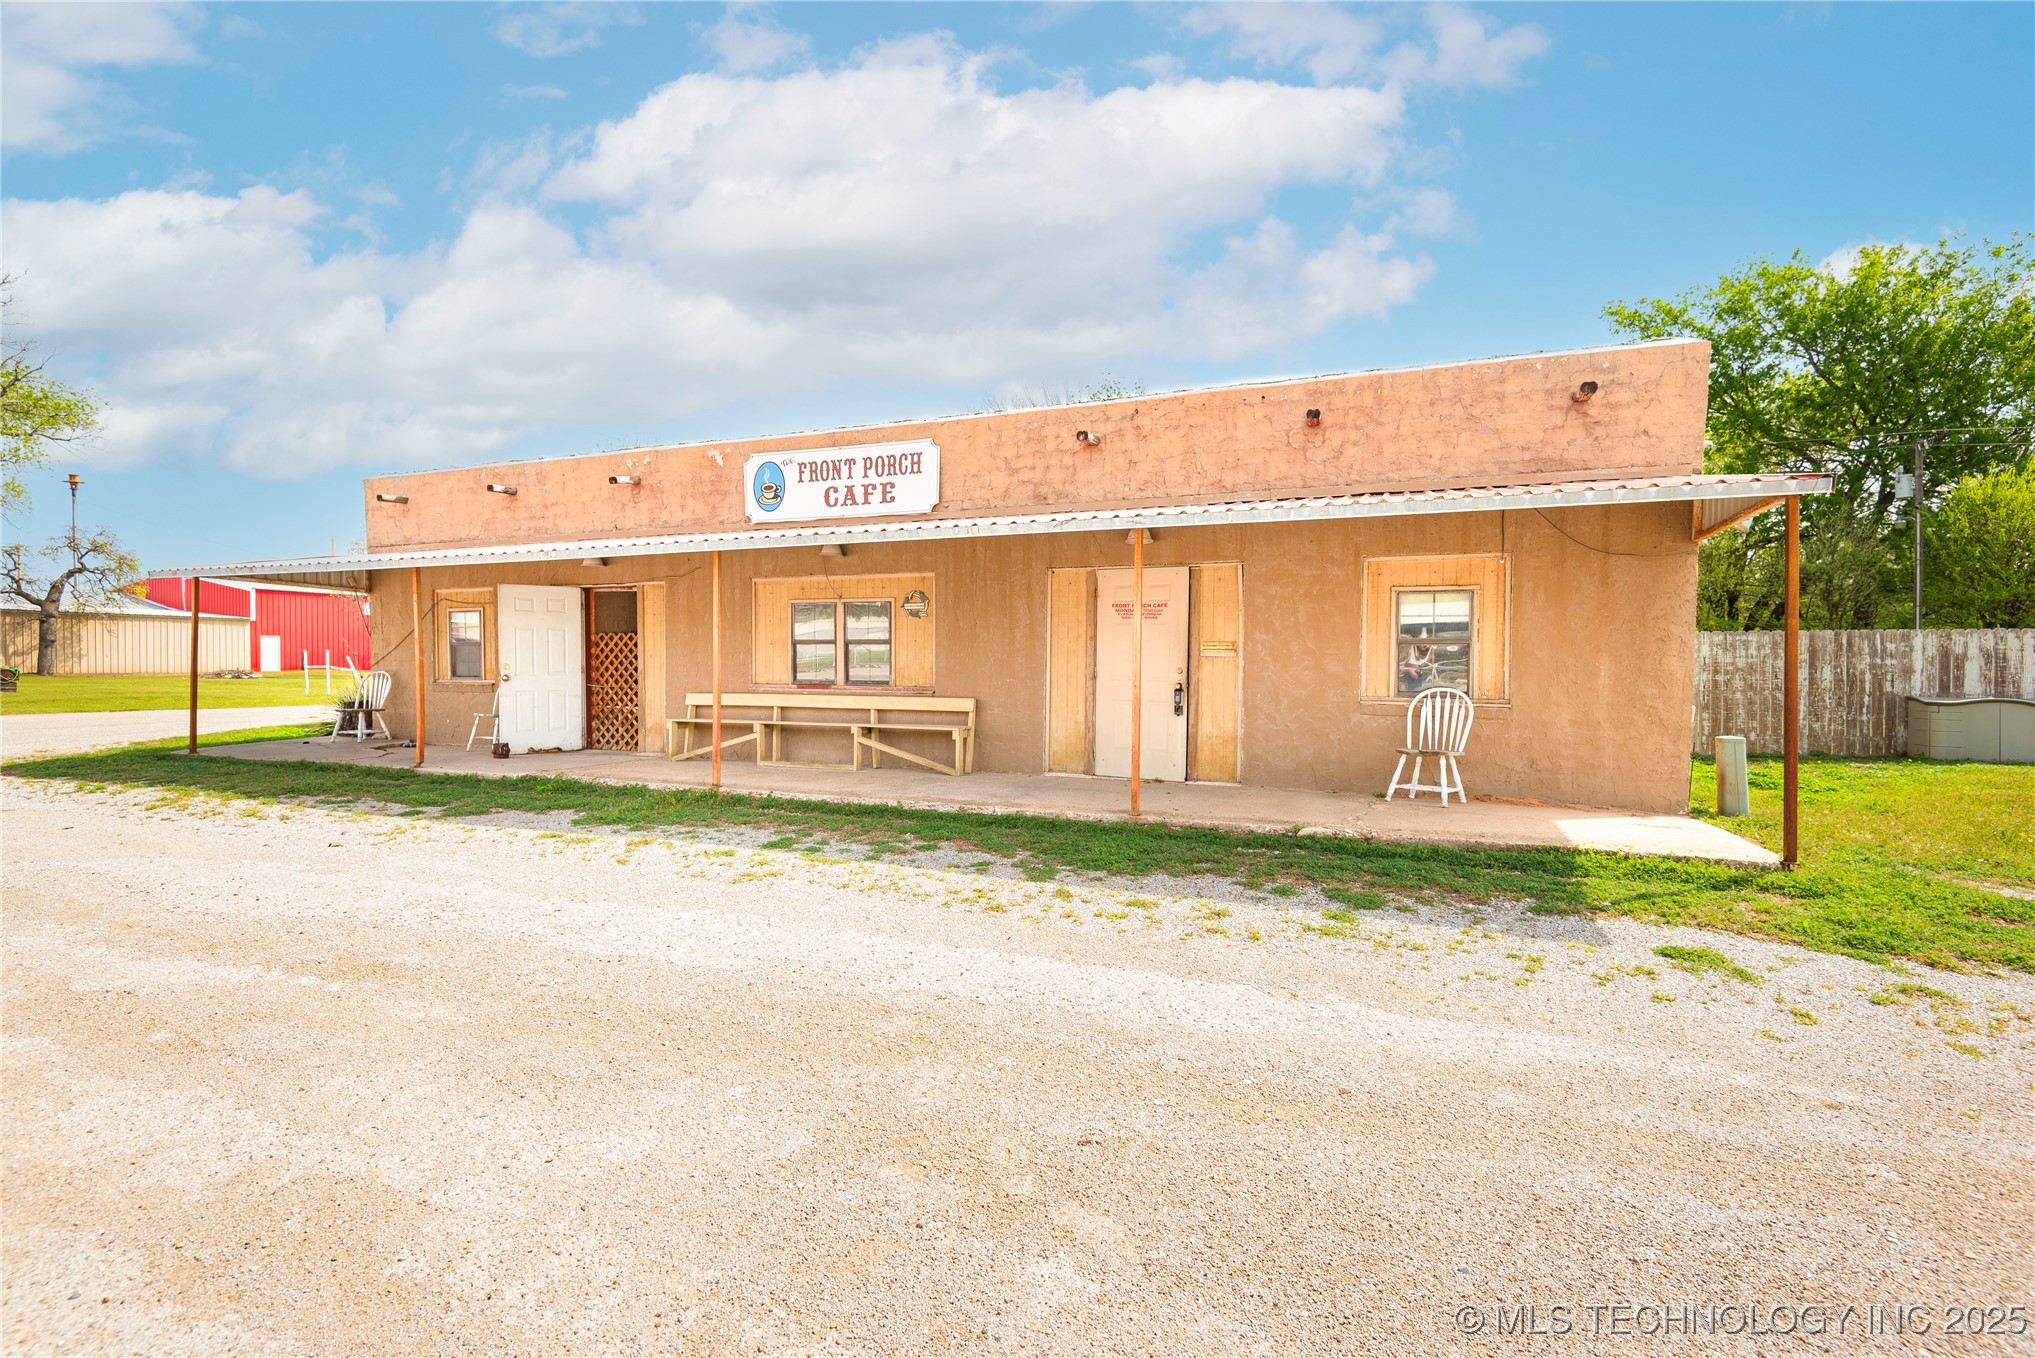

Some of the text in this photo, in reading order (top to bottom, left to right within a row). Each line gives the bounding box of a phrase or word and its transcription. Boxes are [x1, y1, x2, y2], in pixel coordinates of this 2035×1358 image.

[797, 458, 856, 483] FRONT
[862, 452, 922, 478] PORCH
[824, 482, 896, 507] CAFE
